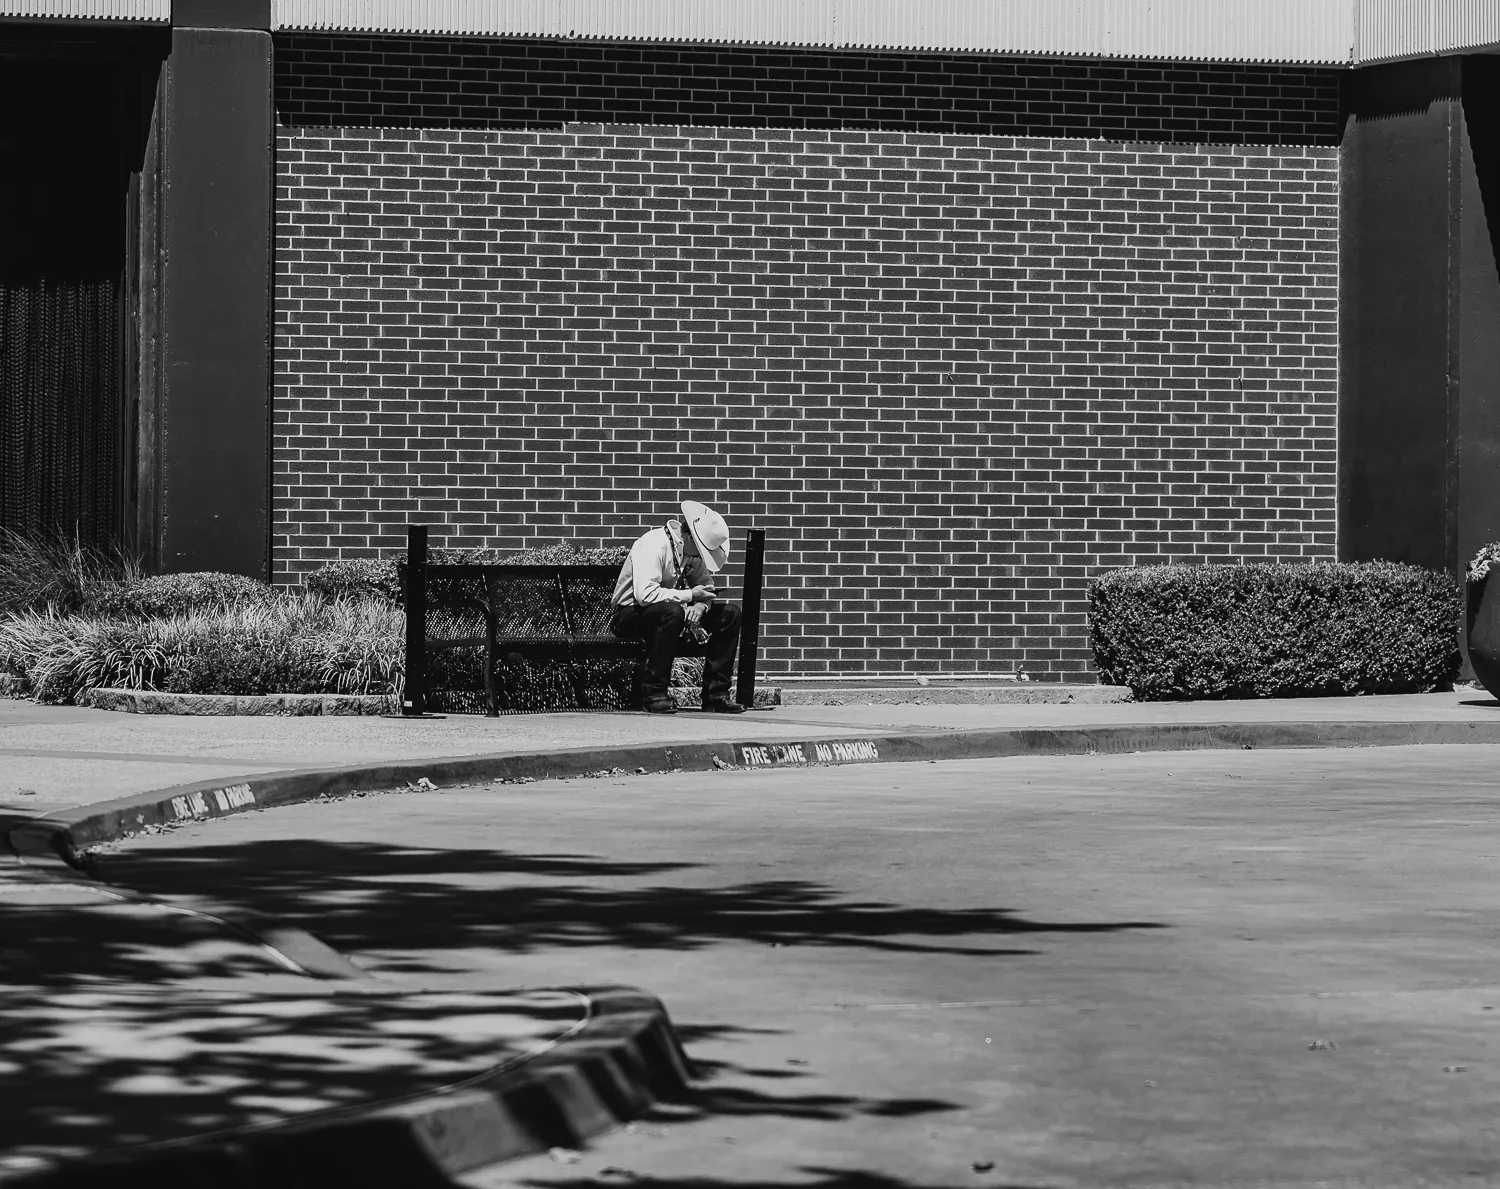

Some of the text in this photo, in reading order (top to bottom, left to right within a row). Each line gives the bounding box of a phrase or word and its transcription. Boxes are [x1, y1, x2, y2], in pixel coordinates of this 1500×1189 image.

[740, 746, 771, 765] FIRE
[815, 743, 832, 761] NO
[832, 741, 880, 761] PARKING
